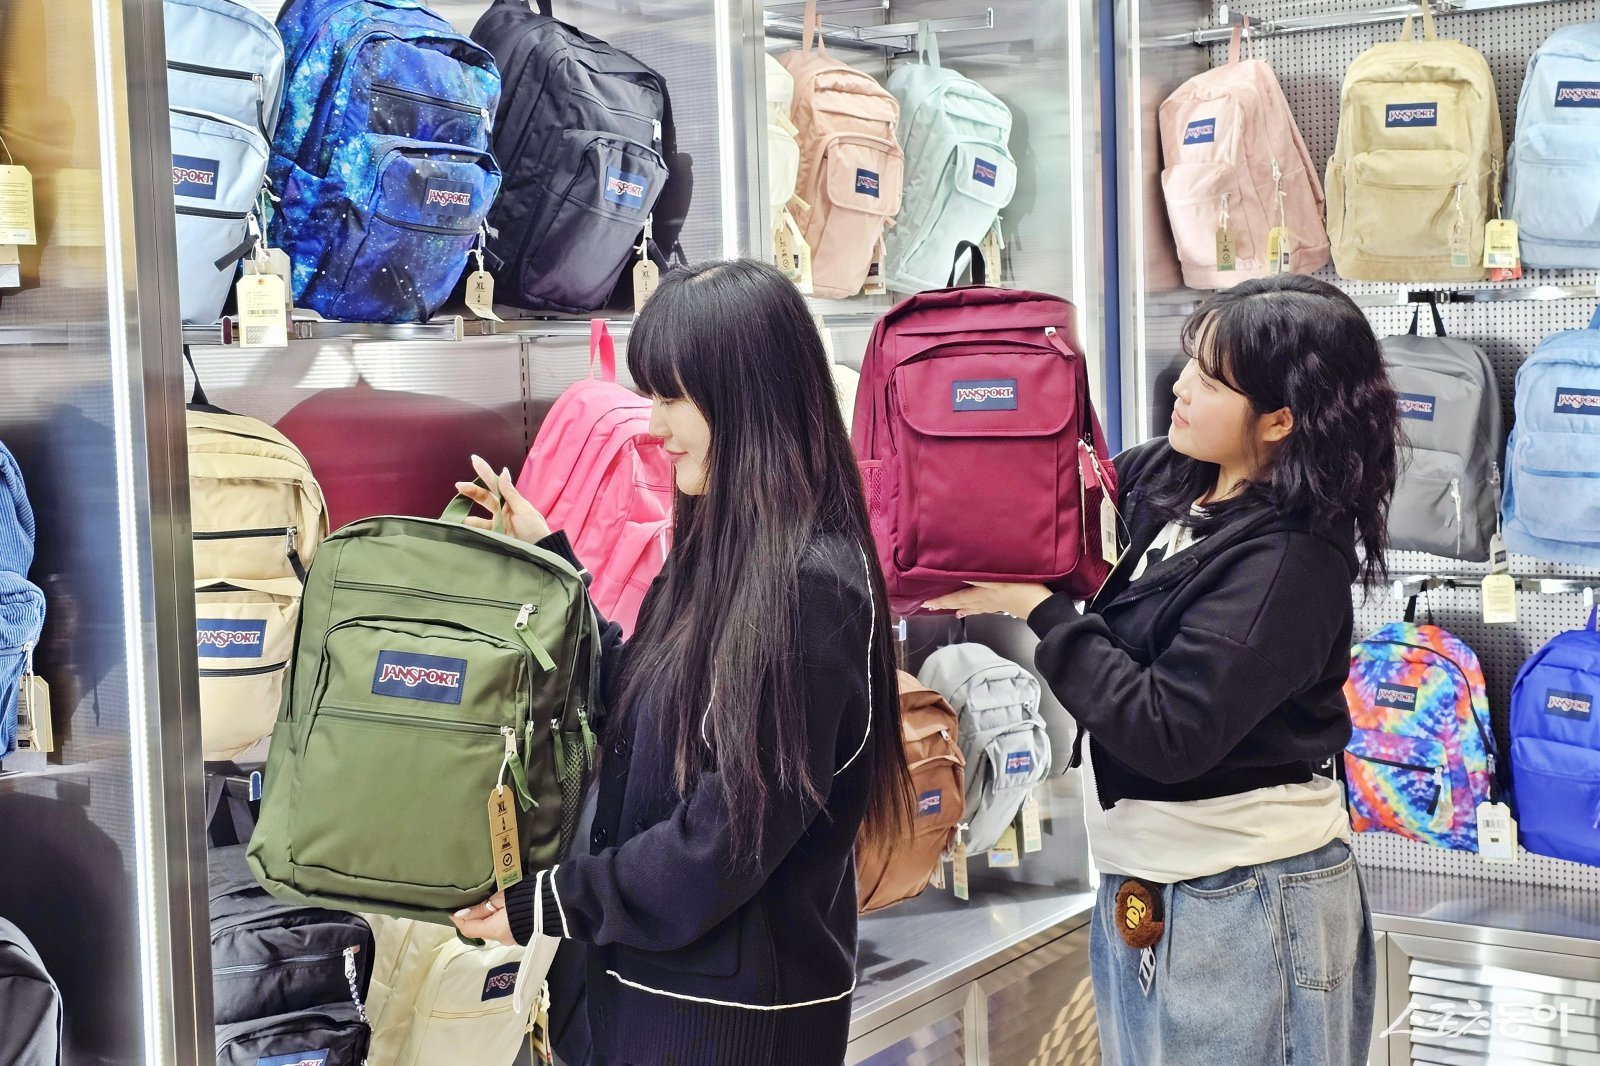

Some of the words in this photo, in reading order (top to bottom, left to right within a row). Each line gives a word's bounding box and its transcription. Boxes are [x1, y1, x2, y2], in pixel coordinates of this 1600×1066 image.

[1557, 88, 1600, 101] JANSPOR
[1388, 108, 1435, 122] JANSPORT
[172, 167, 214, 186] SPORT
[607, 177, 643, 198] JANSPORT
[426, 189, 471, 206] JANSPORT
[475, 282, 486, 290] XL
[956, 387, 1013, 402] JANSPORT
[1557, 393, 1600, 408] JANSPOR
[197, 630, 260, 648] JANSPORT
[379, 663, 460, 688] JANSPORT
[1376, 688, 1415, 703] JANSPORT
[1547, 695, 1590, 712] JANSPORT
